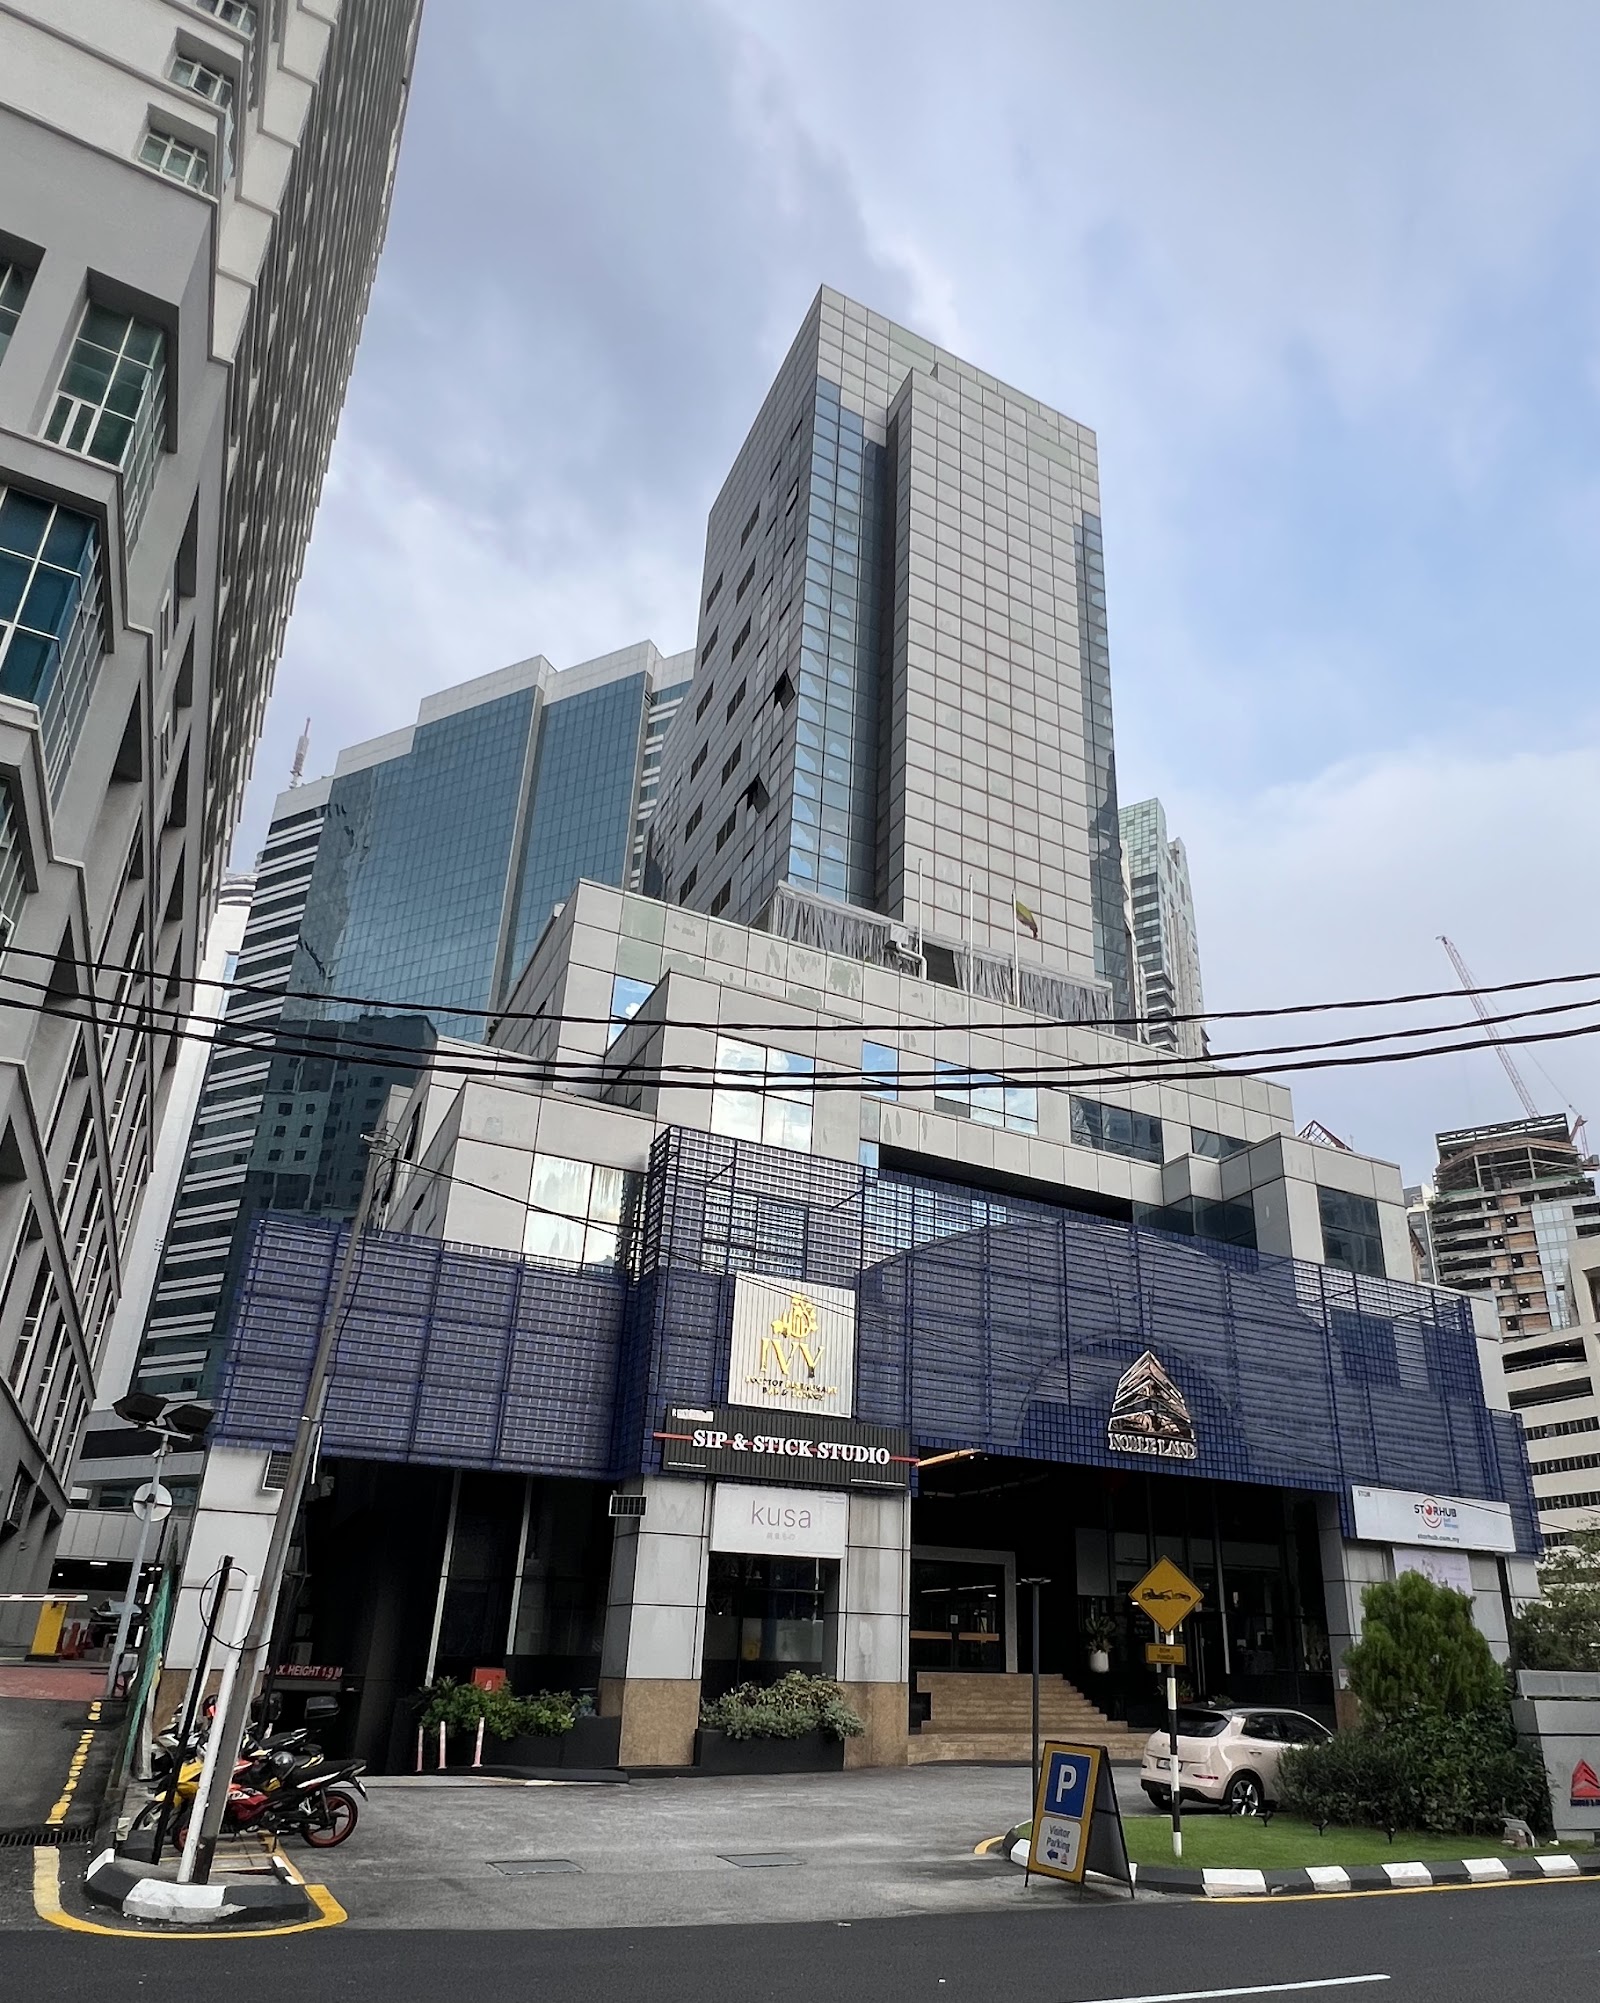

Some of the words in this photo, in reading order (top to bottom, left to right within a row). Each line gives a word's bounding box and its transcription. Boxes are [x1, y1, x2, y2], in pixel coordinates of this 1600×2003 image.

[761, 1337, 825, 1378] IVY
[692, 1429, 728, 1449] SIP
[732, 1433, 749, 1452] &
[752, 1436, 813, 1458] STICK
[817, 1442, 890, 1465] STUDIO
[1108, 1433, 1157, 1454] NOBLE
[1158, 1439, 1198, 1459] LAND
[751, 1500, 811, 1528] kusa
[1413, 1504, 1457, 1518] STORHUB
[288, 1665, 321, 1676] HEIGHT
[1056, 1765, 1077, 1803] P
[1049, 1825, 1071, 1838] Visitor
[1046, 1837, 1071, 1853] Parking
